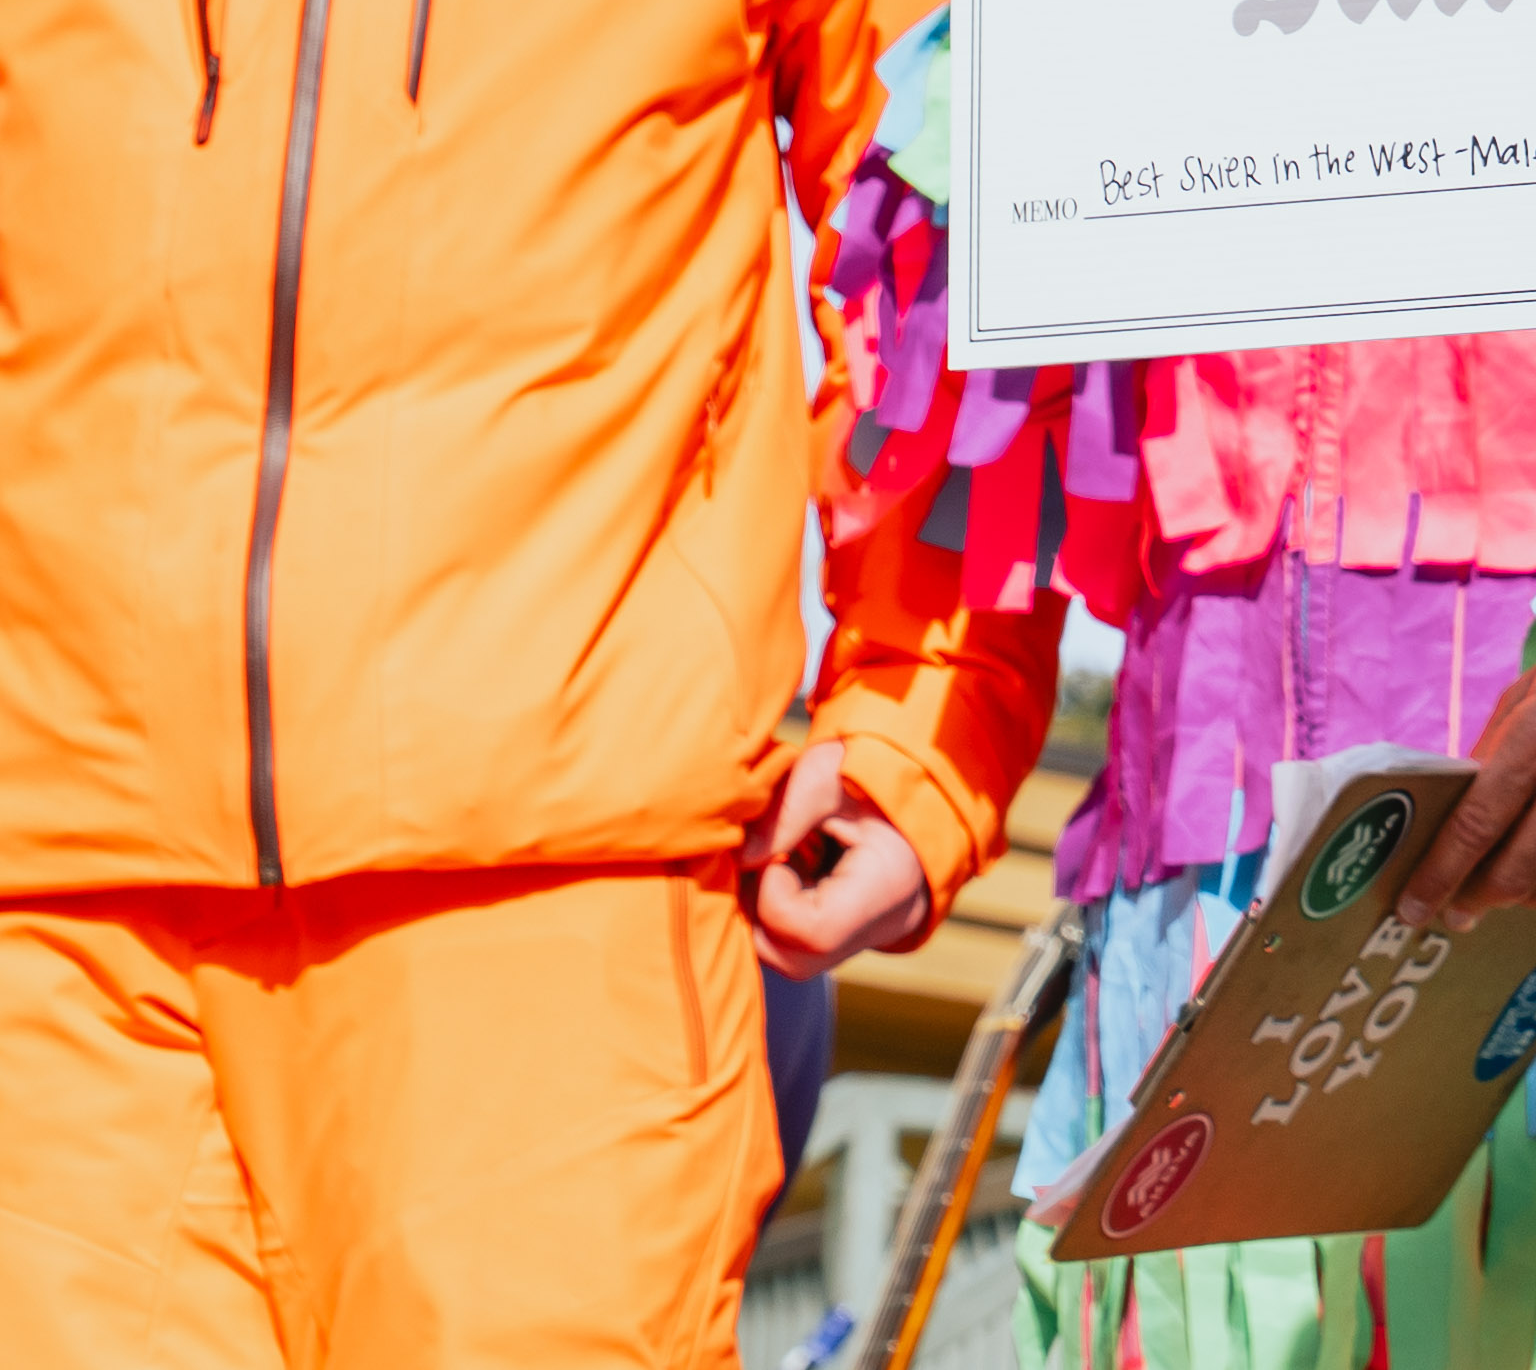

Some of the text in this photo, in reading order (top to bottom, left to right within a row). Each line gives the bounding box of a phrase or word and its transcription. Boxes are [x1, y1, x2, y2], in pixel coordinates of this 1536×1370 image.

[1013, 198, 1078, 223] MEMO
[1099, 159, 1163, 206] Best
[1308, 143, 1355, 181] the
[1250, 915, 1415, 1126] LOVE
[1322, 933, 1450, 1093] YOU
